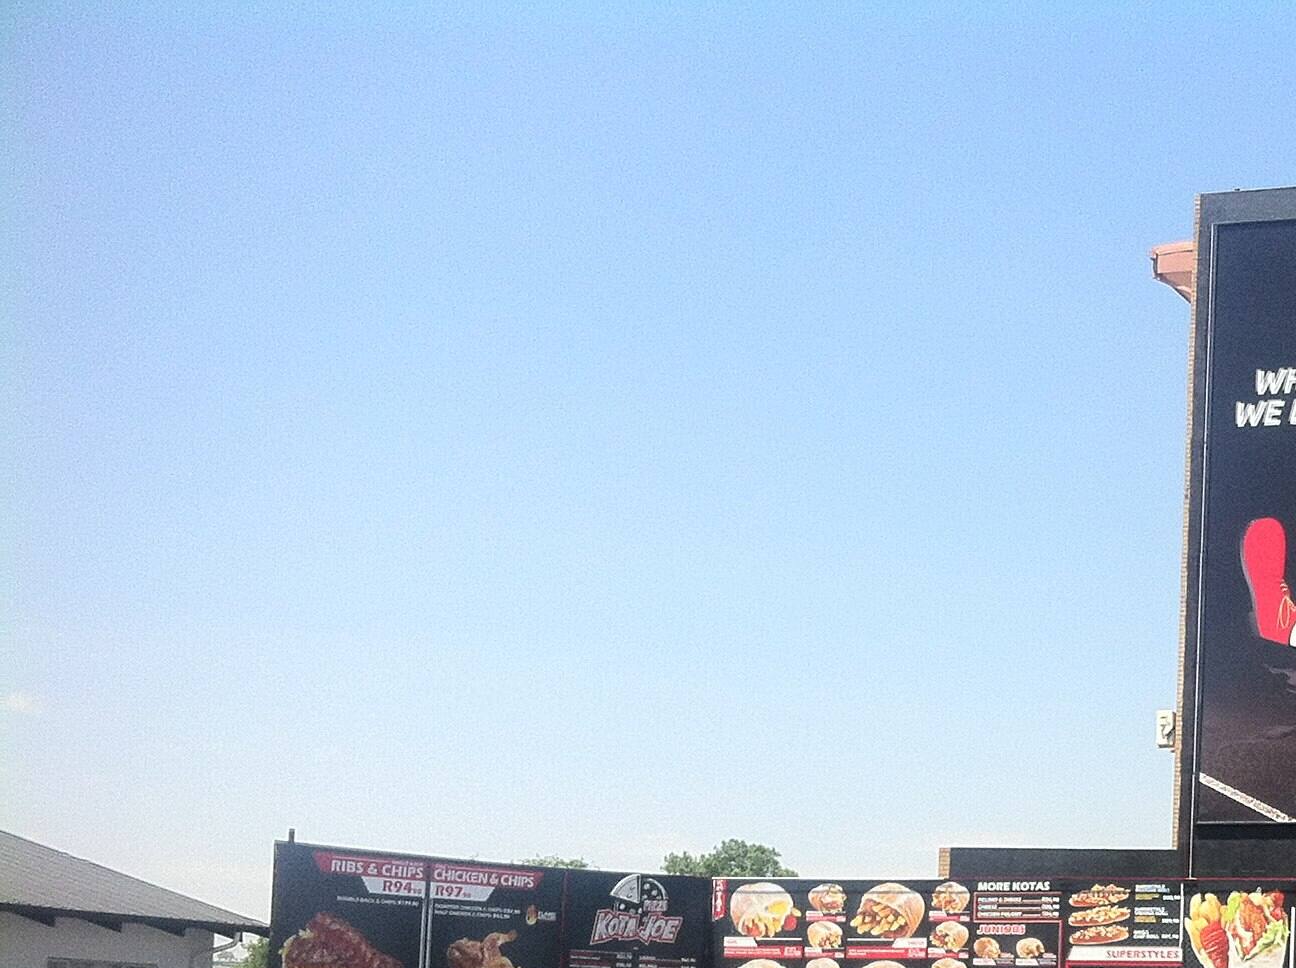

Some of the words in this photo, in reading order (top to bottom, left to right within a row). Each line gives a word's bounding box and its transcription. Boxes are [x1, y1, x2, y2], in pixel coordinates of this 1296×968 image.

[1234, 397, 1286, 428] WE
[331, 859, 364, 873] RIBS
[368, 862, 378, 874] &
[382, 860, 424, 878] CHIPS
[434, 867, 488, 884] CHICKEN
[489, 872, 500, 885] &
[501, 875, 535, 888] CHIPS
[977, 881, 1011, 891] MORE
[1012, 881, 1050, 891] KOTAS
[594, 912, 638, 941] KOTA
[641, 914, 679, 939] JOE
[1105, 950, 1180, 959] SUPERSTYLES
